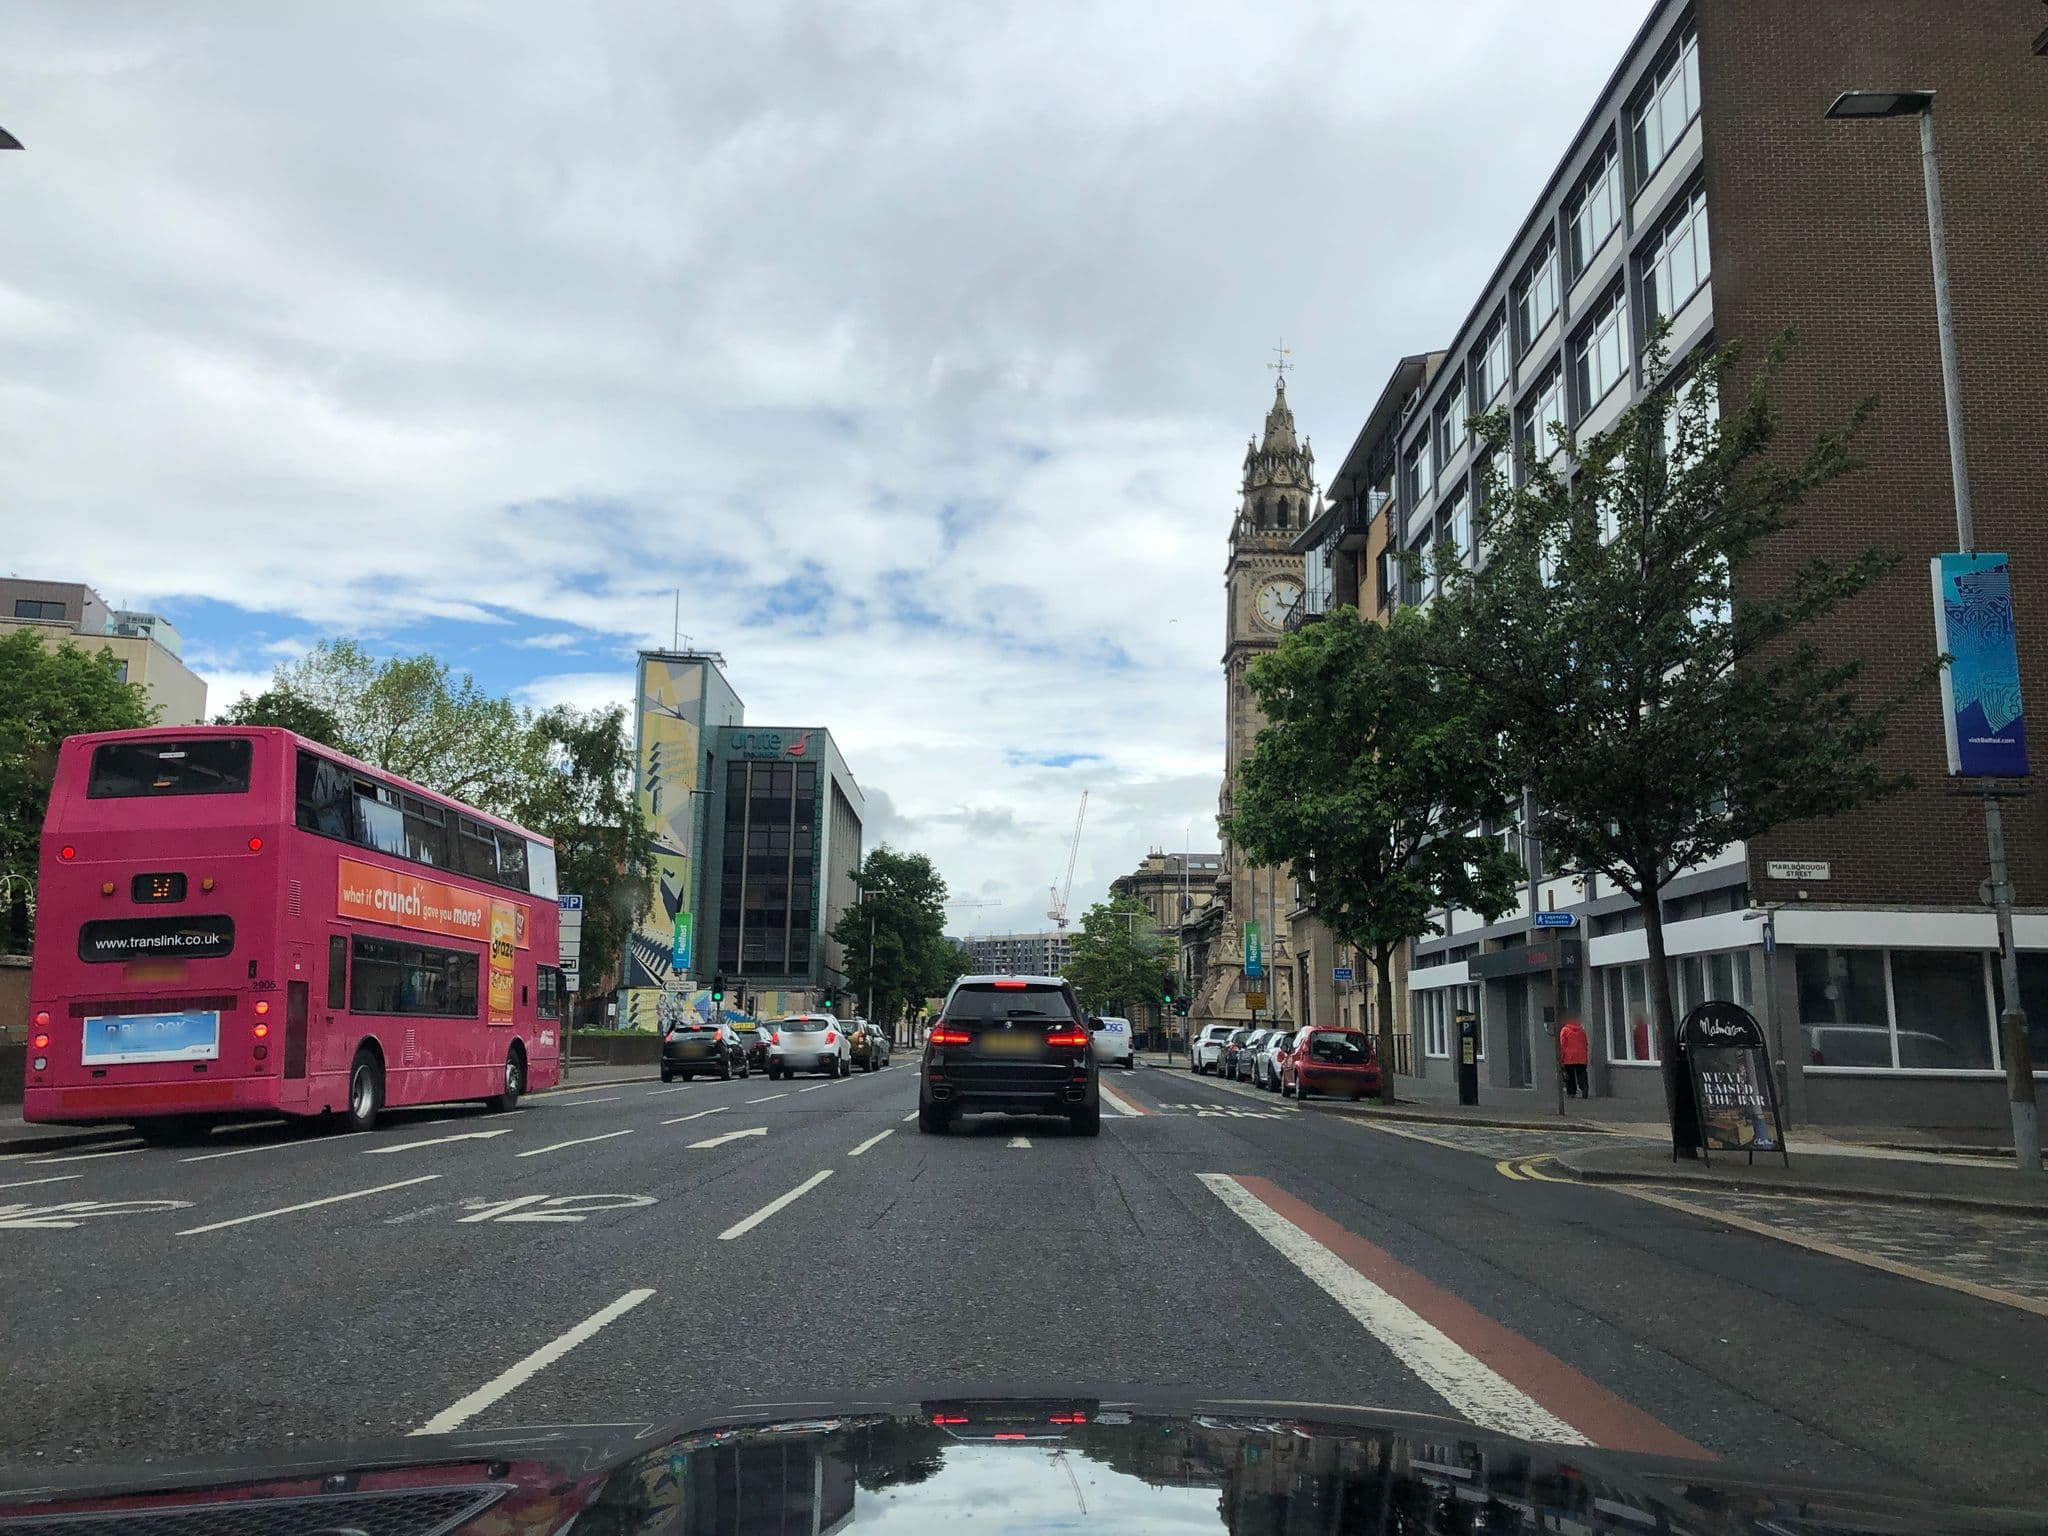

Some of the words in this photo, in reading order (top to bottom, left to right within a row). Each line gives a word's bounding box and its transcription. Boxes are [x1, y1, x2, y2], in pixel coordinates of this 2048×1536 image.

[1771, 863, 1826, 871] MARLBOROUGH
[343, 885, 365, 904] what
[365, 888, 372, 906] if
[374, 888, 421, 916] crunch
[423, 906, 439, 920] gave
[439, 909, 452, 923] you
[453, 907, 482, 927] more?
[570, 898, 579, 907] P
[95, 932, 220, 950] www.translink.co.uk
[678, 924, 687, 954] Belfast
[492, 938, 514, 959] graze
[1249, 933, 1258, 962] Belfast
[252, 981, 276, 990] 2905
[1463, 1022, 1470, 1032] P
[1700, 1016, 1748, 1037] Malmaison
[1702, 1072, 1744, 1083] WE'VE
[1704, 1083, 1754, 1095] RAISED
[1705, 1094, 1734, 1106] THE
[1738, 1095, 1766, 1107] BAR
